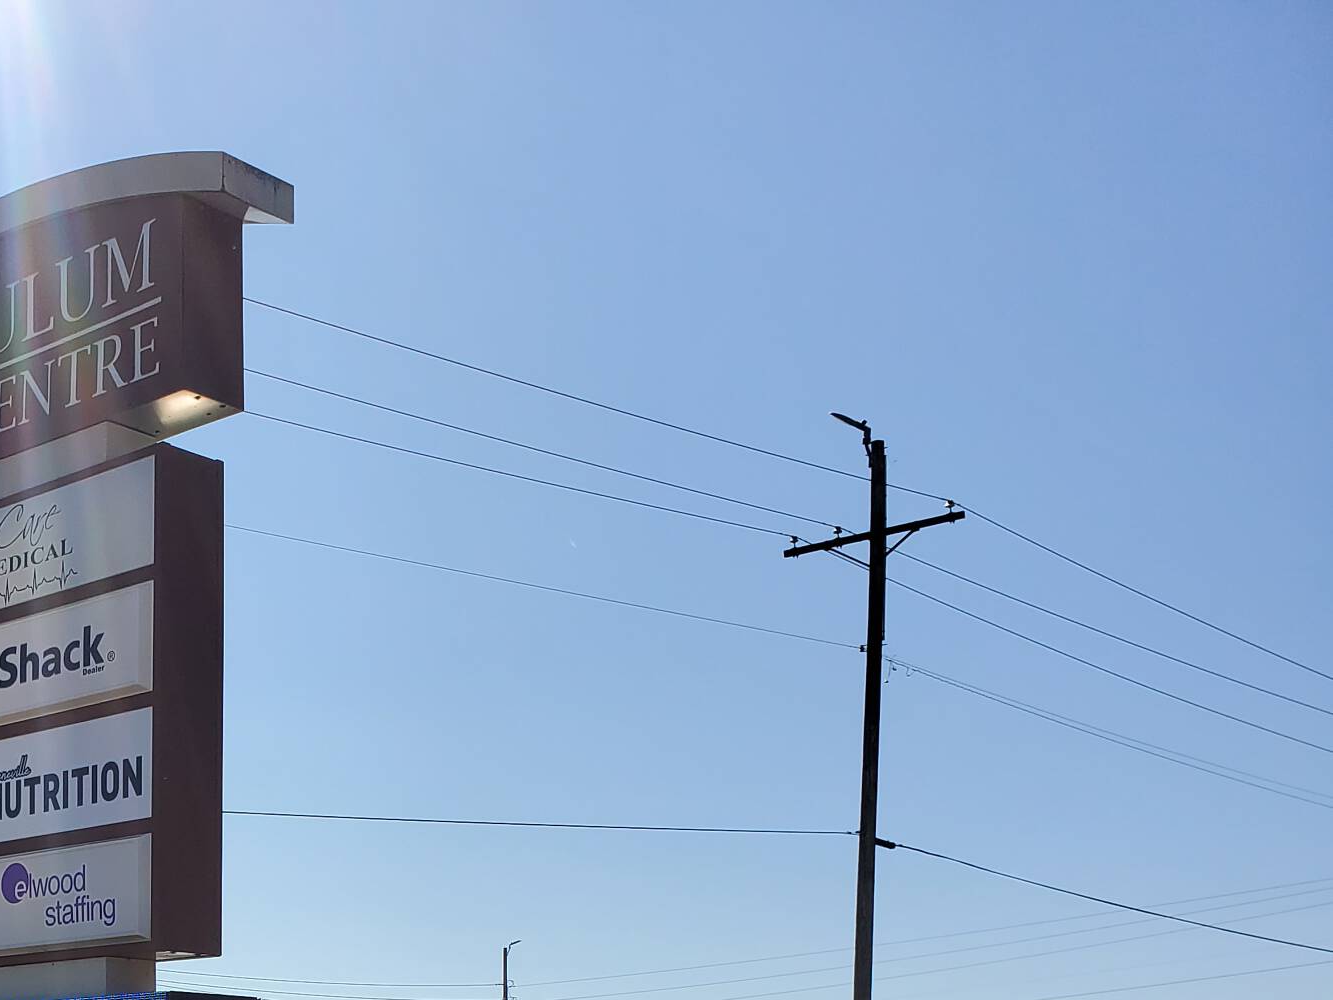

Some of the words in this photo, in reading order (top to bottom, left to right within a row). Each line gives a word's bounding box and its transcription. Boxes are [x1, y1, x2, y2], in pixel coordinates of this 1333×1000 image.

[82, 665, 105, 676] Dealer
[14, 863, 87, 900] elwood
[45, 894, 117, 927] staffing
